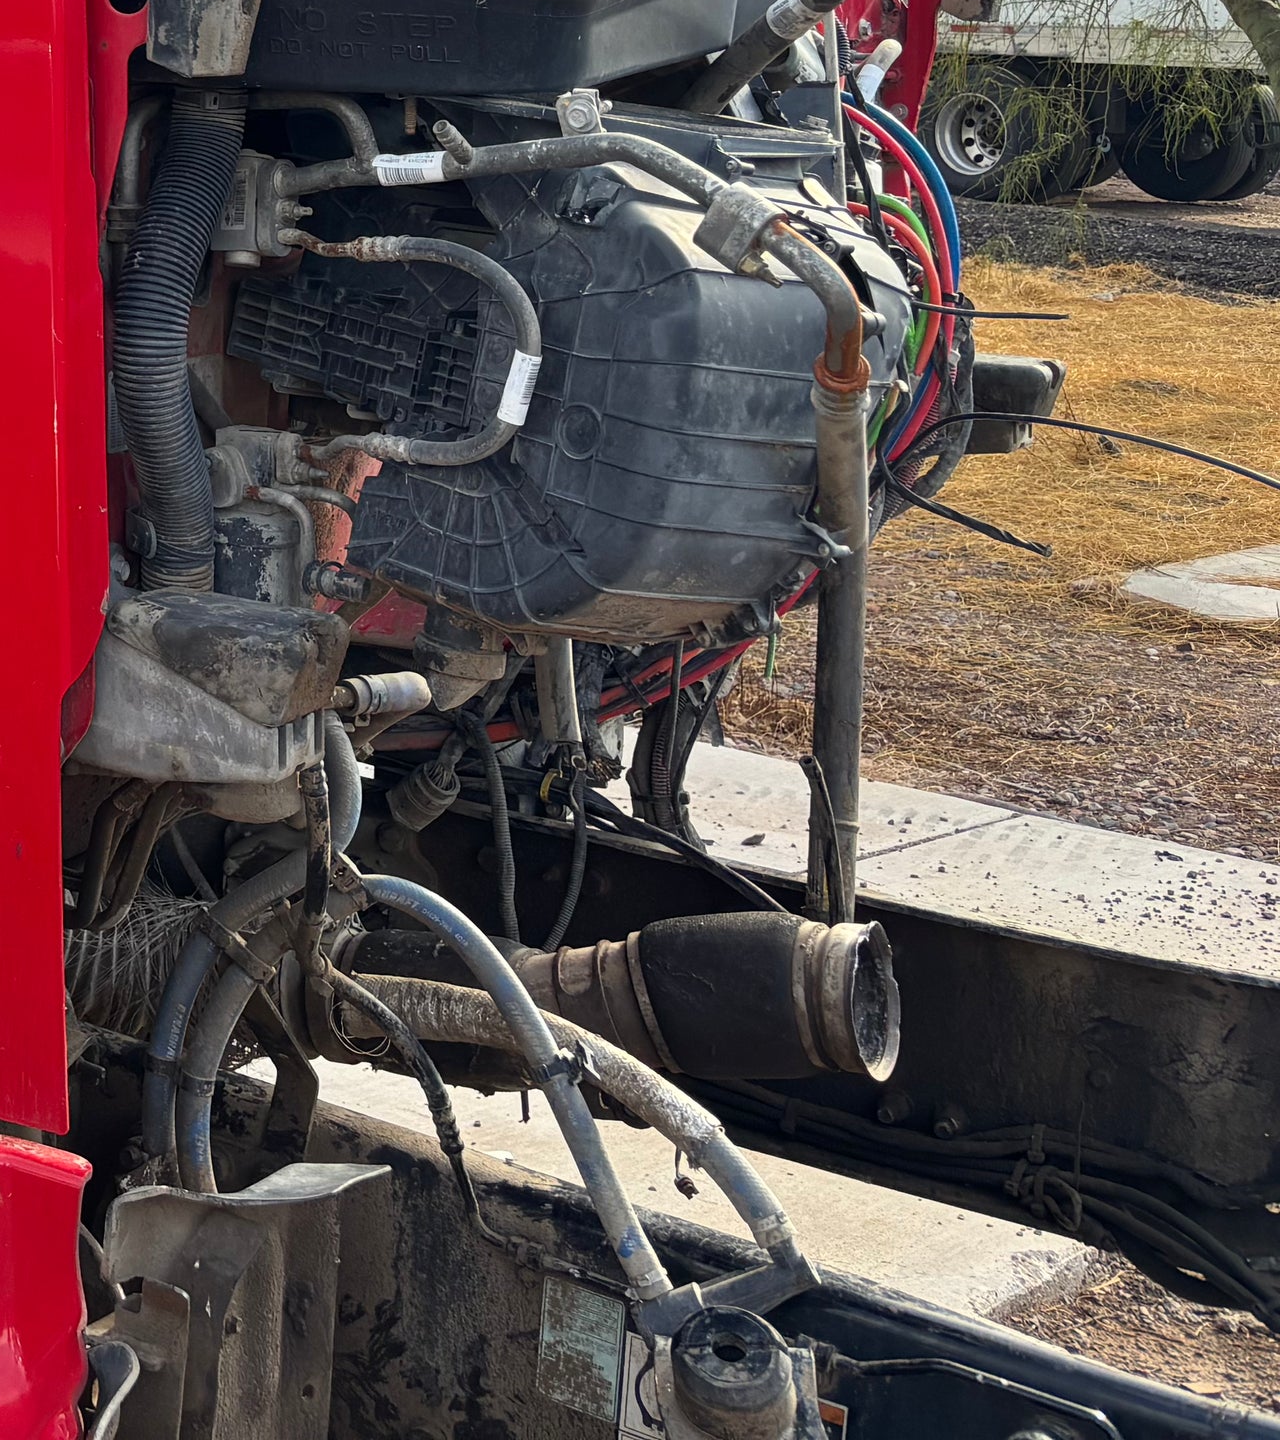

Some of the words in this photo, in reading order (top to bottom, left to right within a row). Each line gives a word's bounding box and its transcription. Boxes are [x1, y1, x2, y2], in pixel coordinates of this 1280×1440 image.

[278, 7, 327, 32] NO
[356, 11, 457, 37] STEP
[269, 38, 303, 55] DO
[320, 40, 372, 58] NOT
[391, 44, 462, 63] PULL
